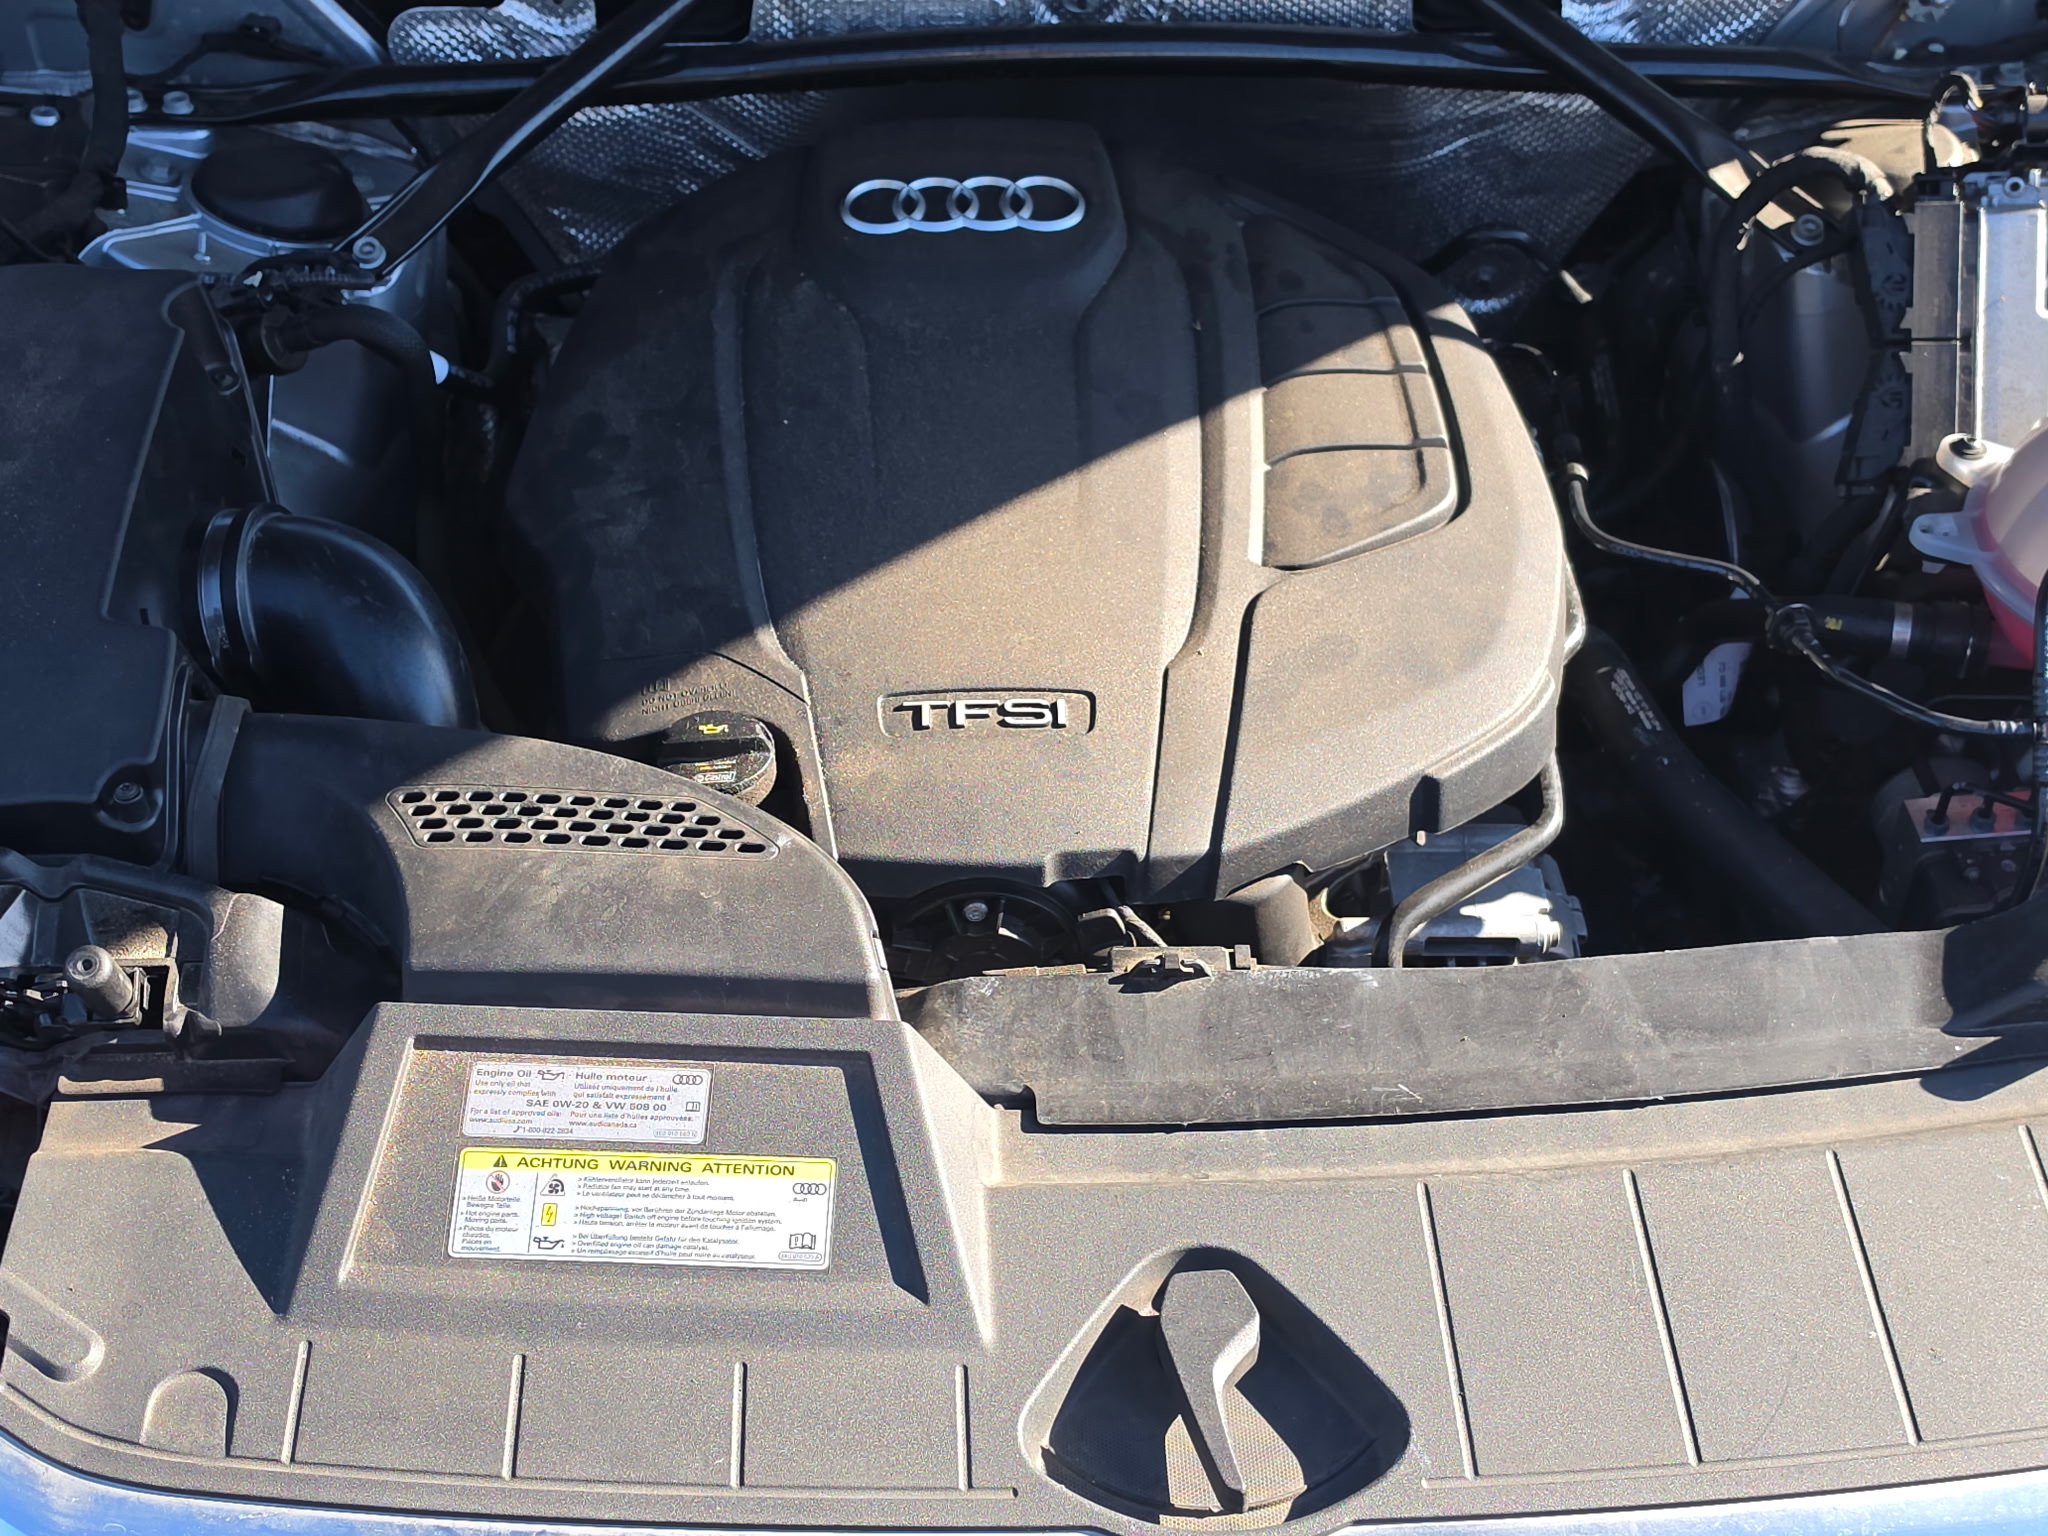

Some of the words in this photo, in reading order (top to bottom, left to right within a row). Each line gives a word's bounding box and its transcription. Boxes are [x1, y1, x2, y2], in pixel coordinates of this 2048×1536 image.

[894, 697, 1068, 731] TFSI
[476, 1068, 514, 1078] Engine
[517, 1069, 532, 1078] Oil
[575, 1071, 603, 1081] Huile
[606, 1074, 648, 1082] moteur
[526, 1099, 550, 1107] SAE
[552, 1100, 590, 1108] 0W-20
[592, 1101, 603, 1109] &
[605, 1101, 628, 1110] VW
[653, 1103, 667, 1111] 00
[517, 1157, 599, 1170] ACHTUNG
[609, 1160, 692, 1173] WARNING
[702, 1163, 795, 1176] ATTENTION
